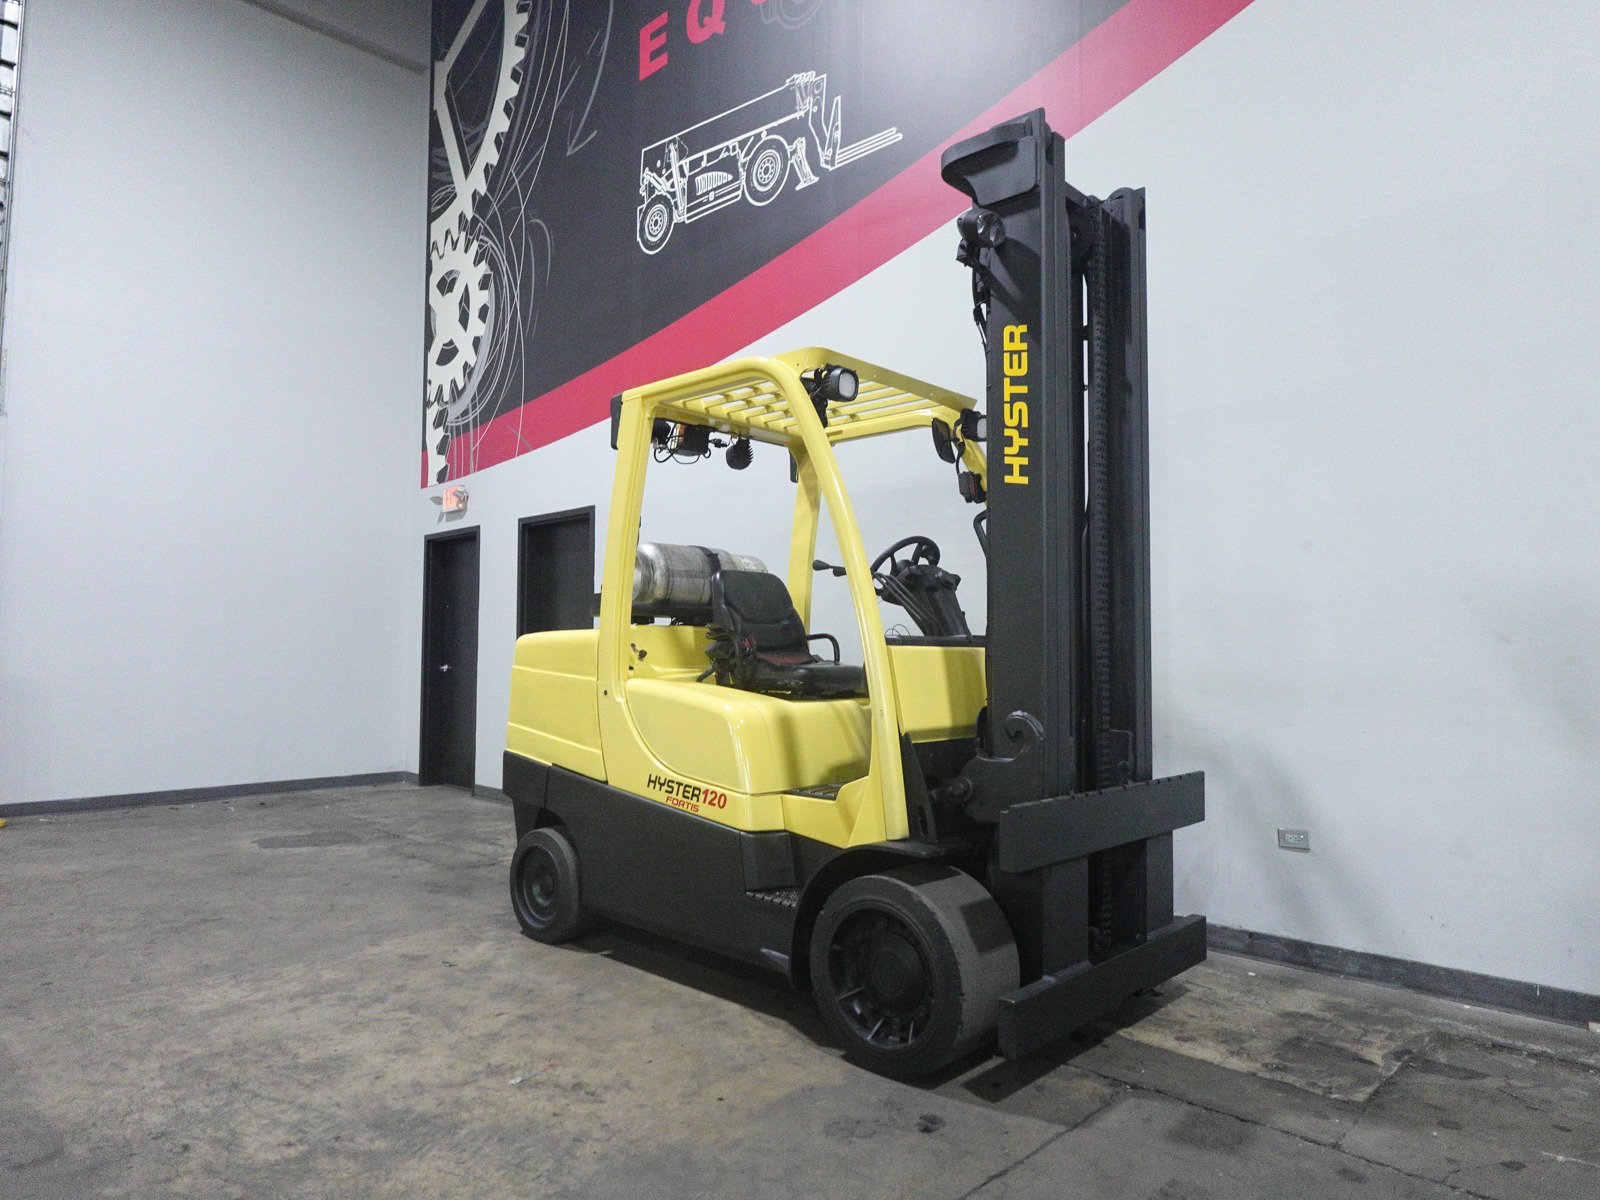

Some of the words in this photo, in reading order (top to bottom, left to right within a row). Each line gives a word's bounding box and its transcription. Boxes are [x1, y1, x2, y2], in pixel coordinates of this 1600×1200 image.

[639, 0, 768, 81] EQ
[1003, 324, 1029, 485] HYSTER
[647, 774, 702, 802] HYSTER
[702, 789, 727, 809] 120
[665, 796, 700, 813] FORTIS
